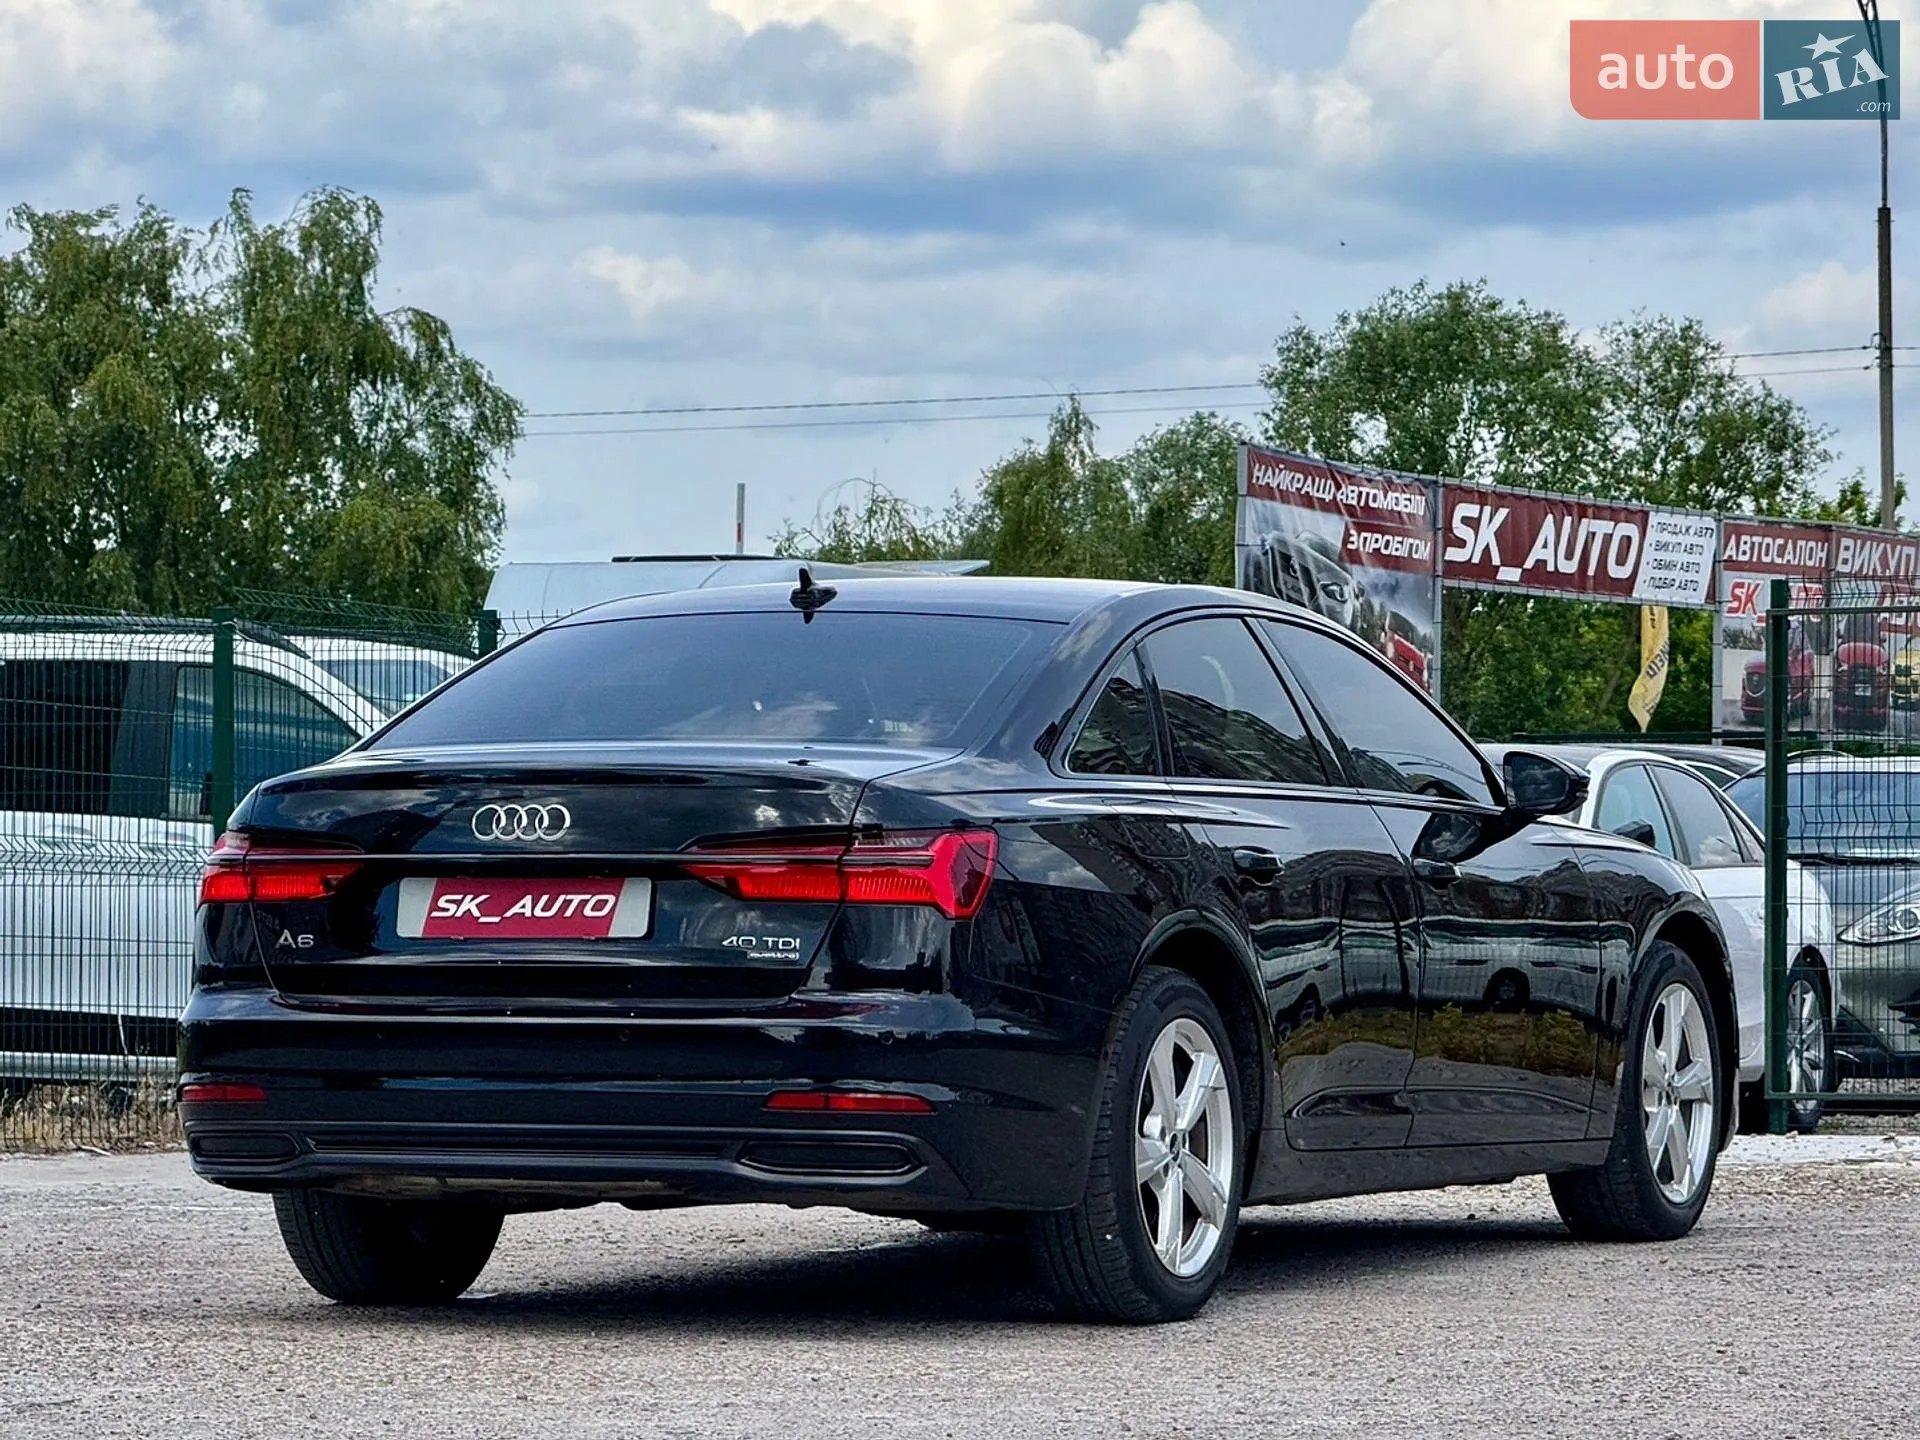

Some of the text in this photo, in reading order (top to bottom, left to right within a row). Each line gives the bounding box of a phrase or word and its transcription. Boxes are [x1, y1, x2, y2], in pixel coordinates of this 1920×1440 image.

[1359, 532, 1432, 562] ПРОБІГОМ
[1444, 503, 1640, 582] SK_AUTO
[1683, 543, 1704, 556] АВТО
[1724, 534, 1829, 568] АВТОСАЛОН
[1679, 561, 1701, 574] АВТО
[1836, 537, 1917, 581] ВИКУП
[1676, 579, 1700, 592] АВТО
[430, 894, 617, 923] SK_AUTO
[275, 928, 315, 948] A6
[721, 936, 800, 950] 40 TDI
